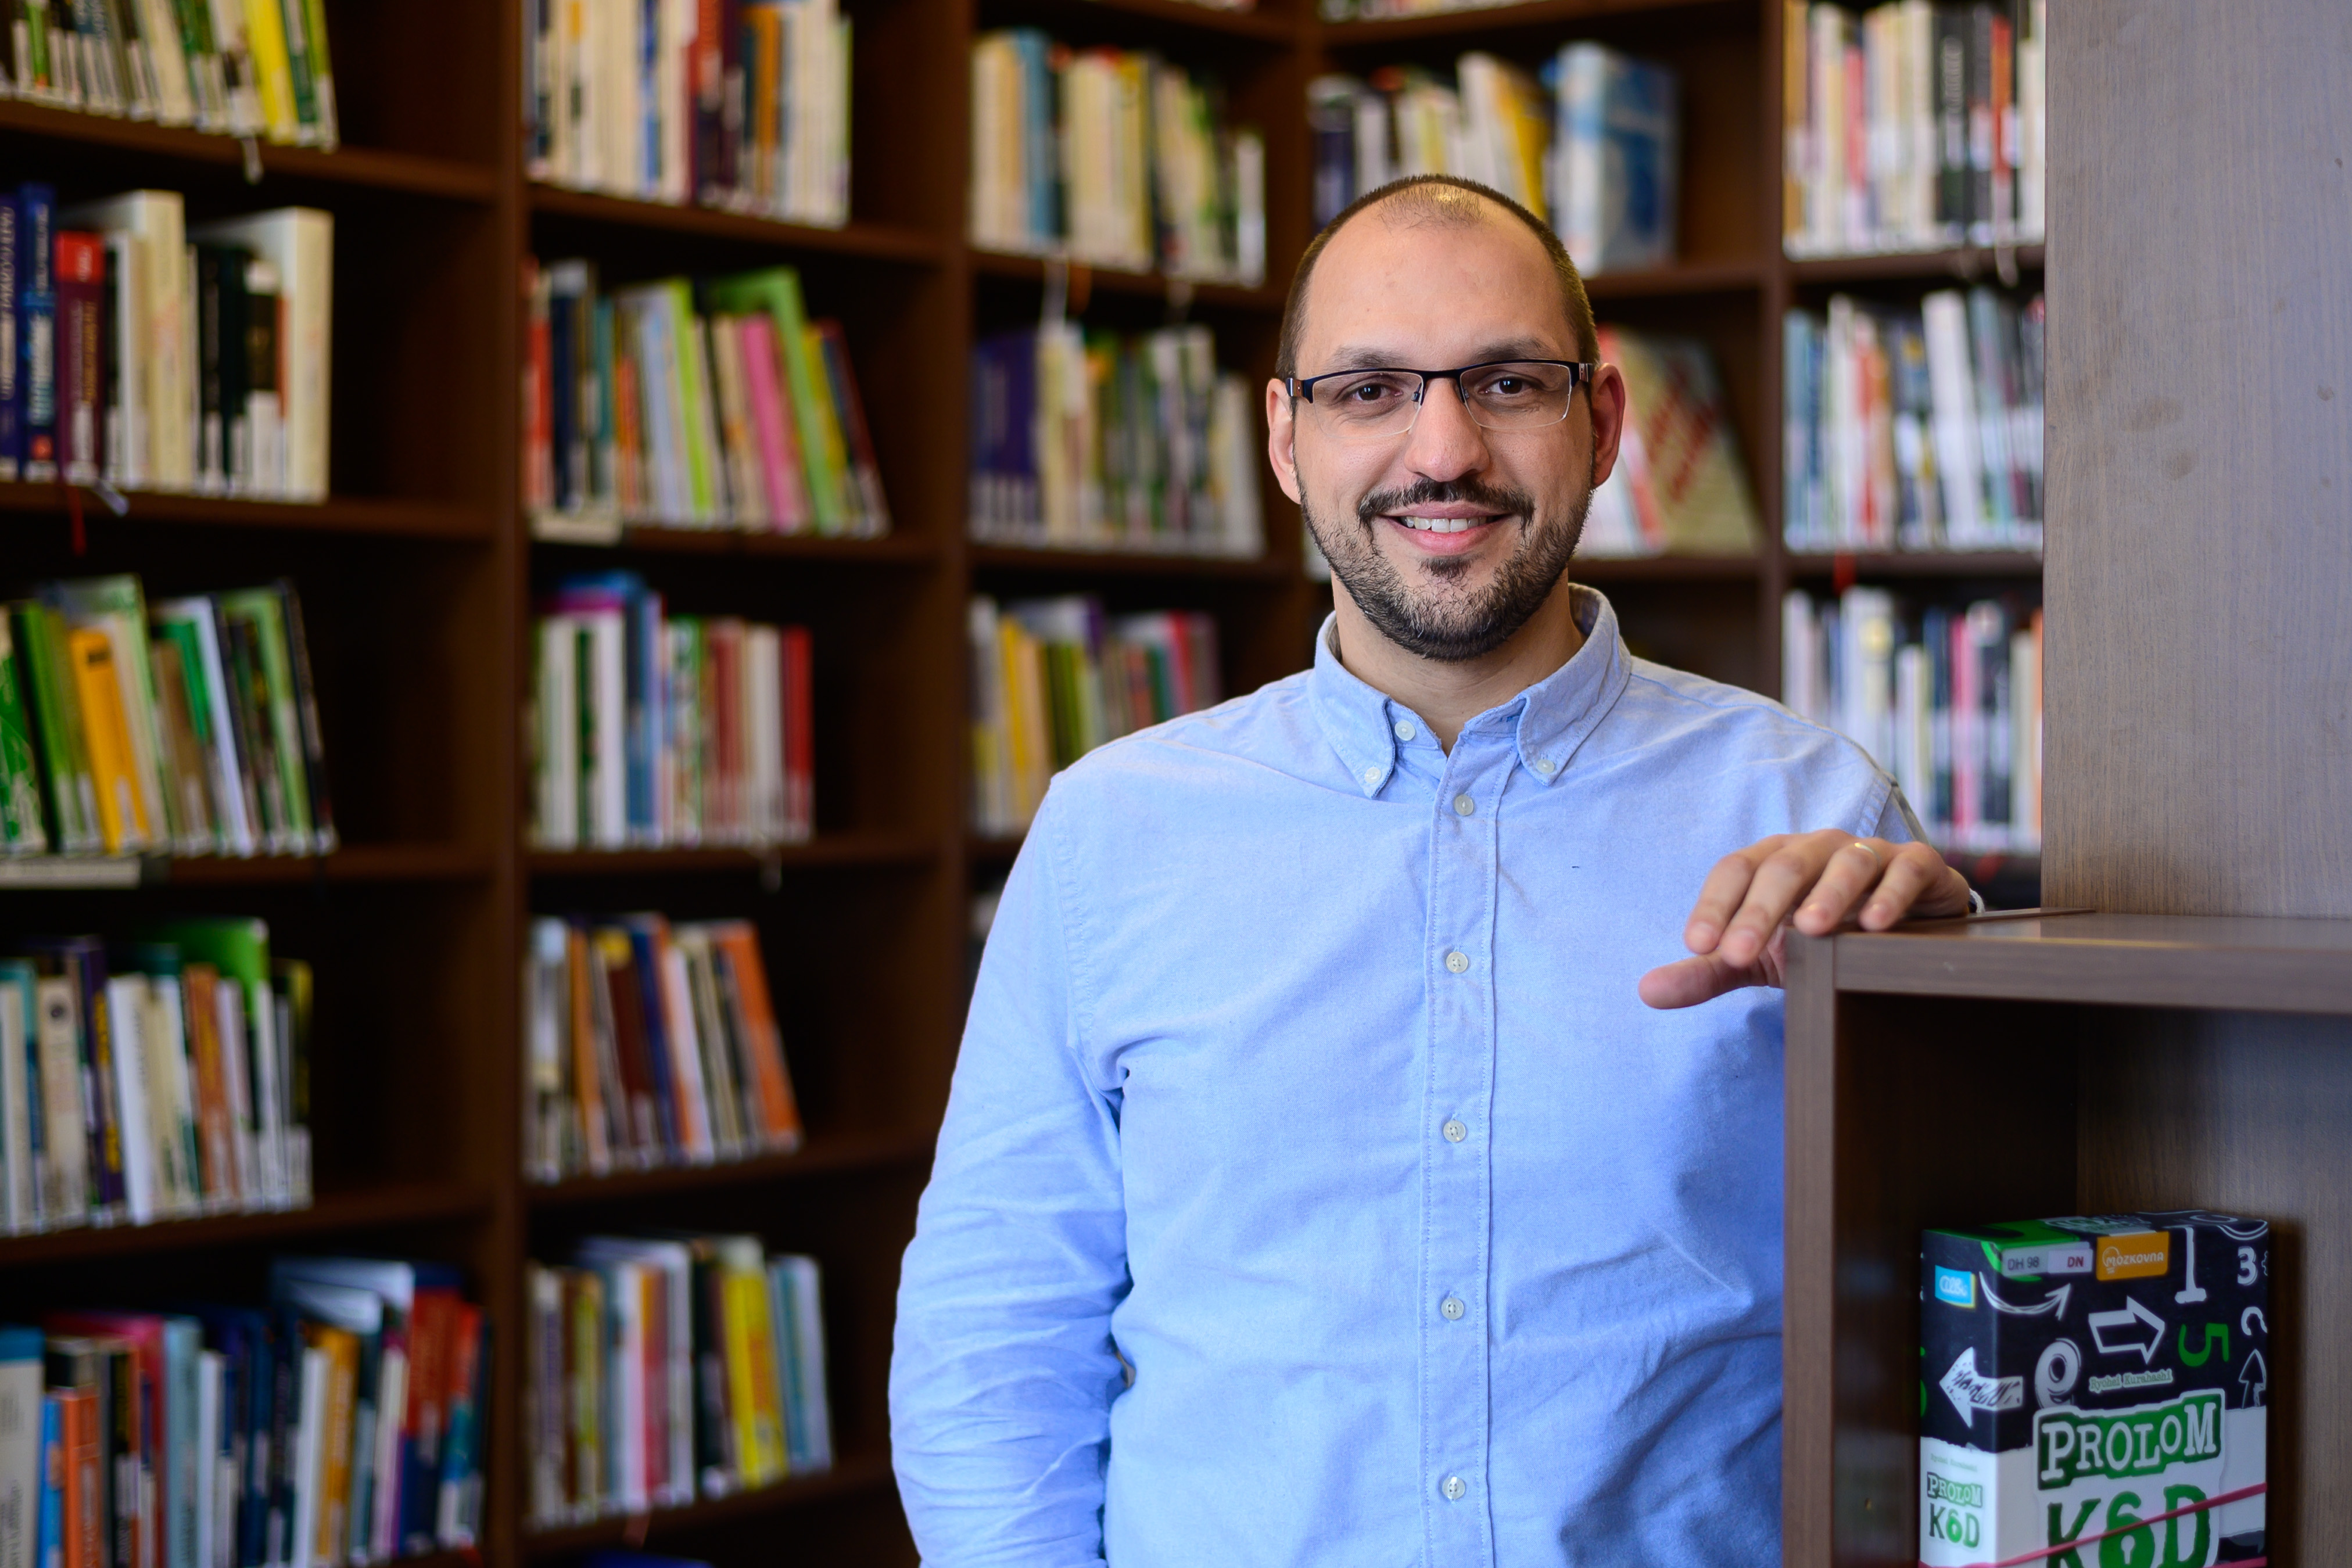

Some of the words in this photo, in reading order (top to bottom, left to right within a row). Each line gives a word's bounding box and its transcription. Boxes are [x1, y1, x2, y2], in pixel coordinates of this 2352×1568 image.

[2007, 1257, 2025, 1271] DH
[2027, 1255, 2041, 1268] 98
[2067, 1256, 2085, 1268] DN
[2237, 1246, 2259, 1286] 3
[2090, 1375, 2121, 1393] Ryohei
[2124, 1368, 2172, 1387] Kurahashi
[2041, 1402, 2217, 1481] PROLOM
[1927, 1474, 1982, 1507] PROLOM
